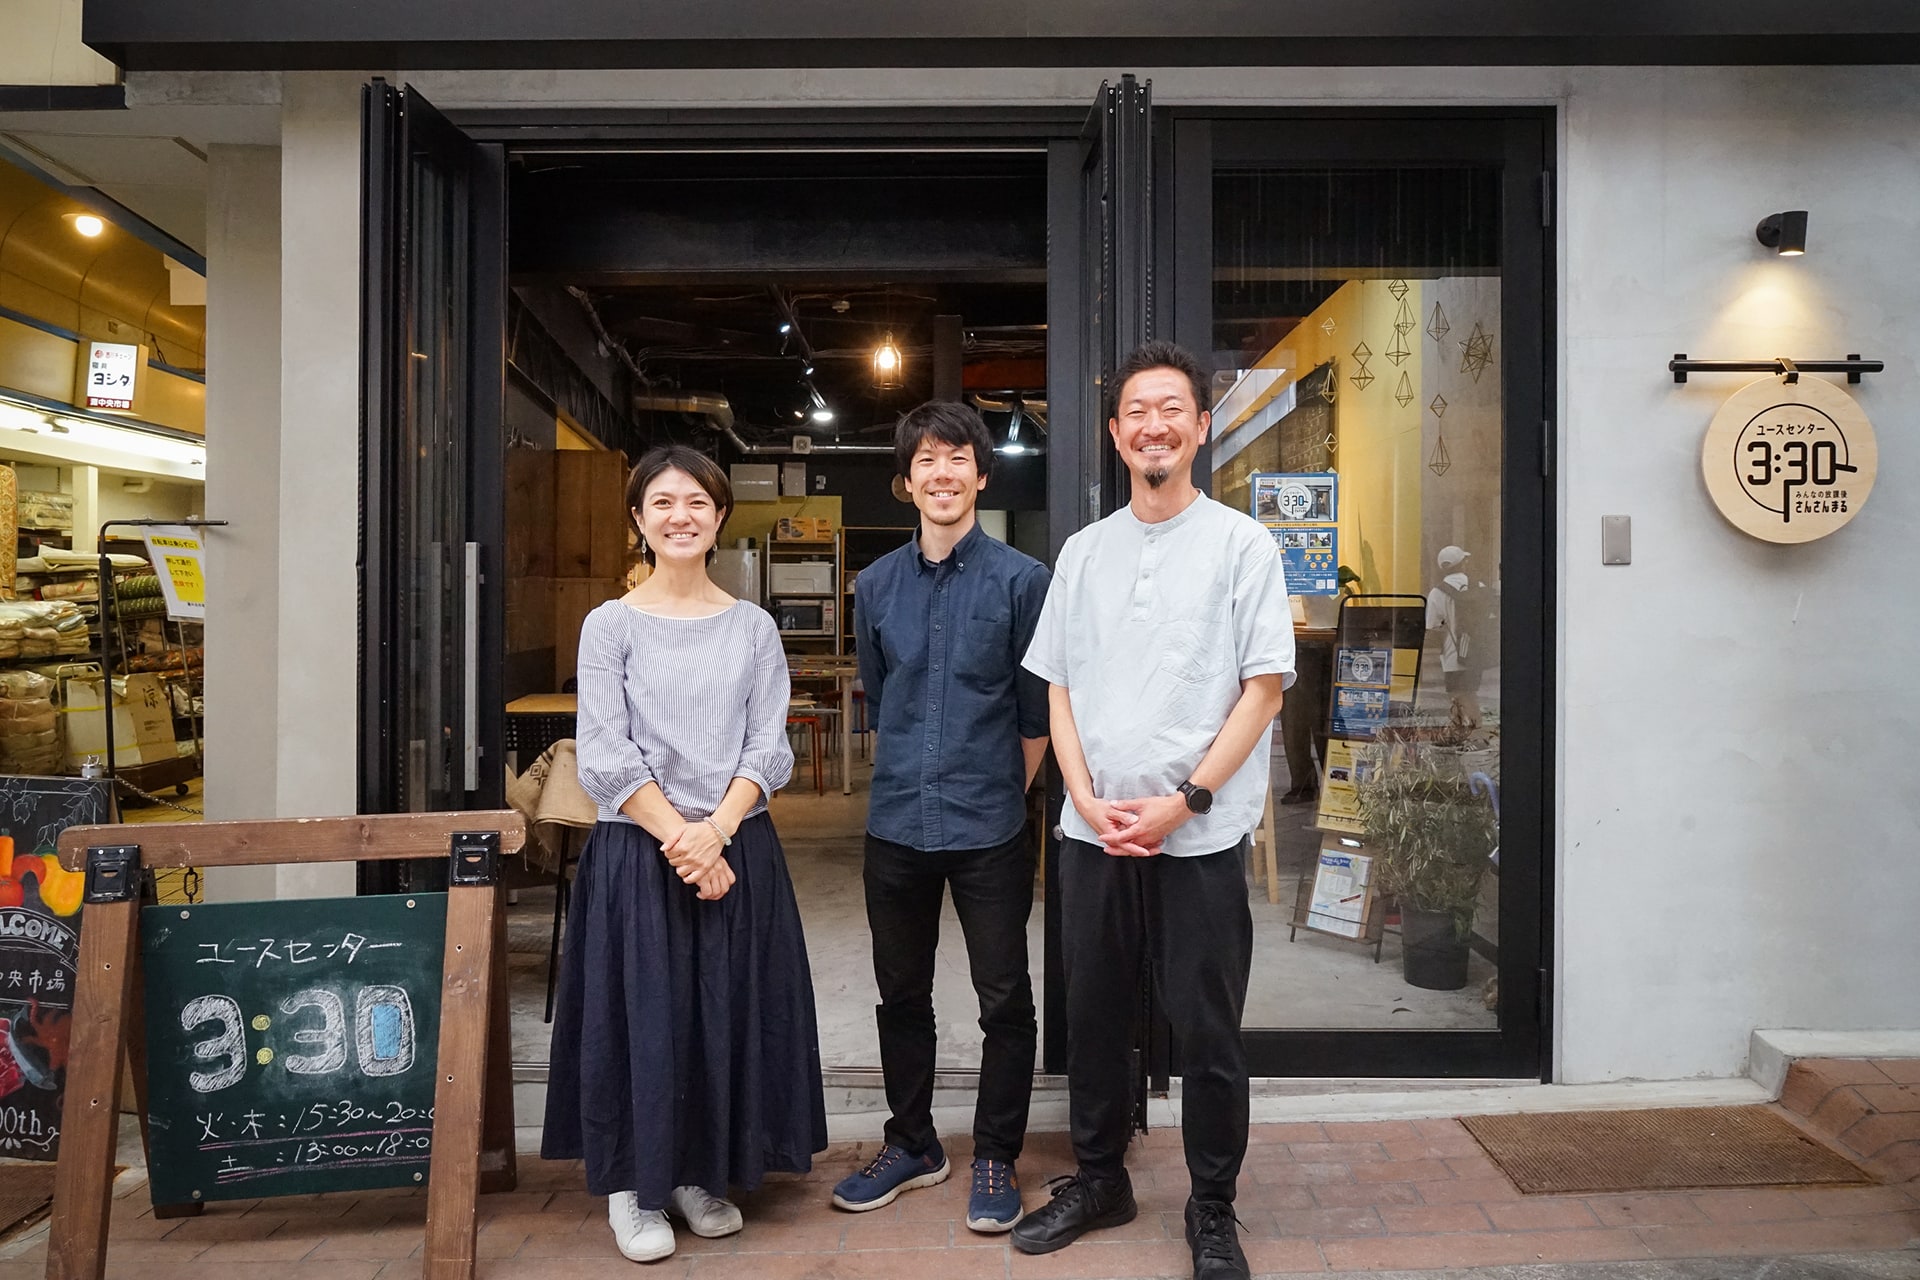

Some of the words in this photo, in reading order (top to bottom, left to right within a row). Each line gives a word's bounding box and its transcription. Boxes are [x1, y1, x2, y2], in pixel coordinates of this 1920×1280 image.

[93, 372, 130, 387] ヨシタ
[1756, 423, 1826, 436] ユースセンター
[1747, 441, 1837, 486] 3:30
[1795, 490, 1849, 499] みんなの放課後
[1795, 500, 1848, 514] さんさんまる
[196, 932, 403, 969] ユースセンター
[0, 969, 65, 994] 央市場
[181, 984, 416, 1093] 3:30
[0, 1106, 42, 1136] 0th
